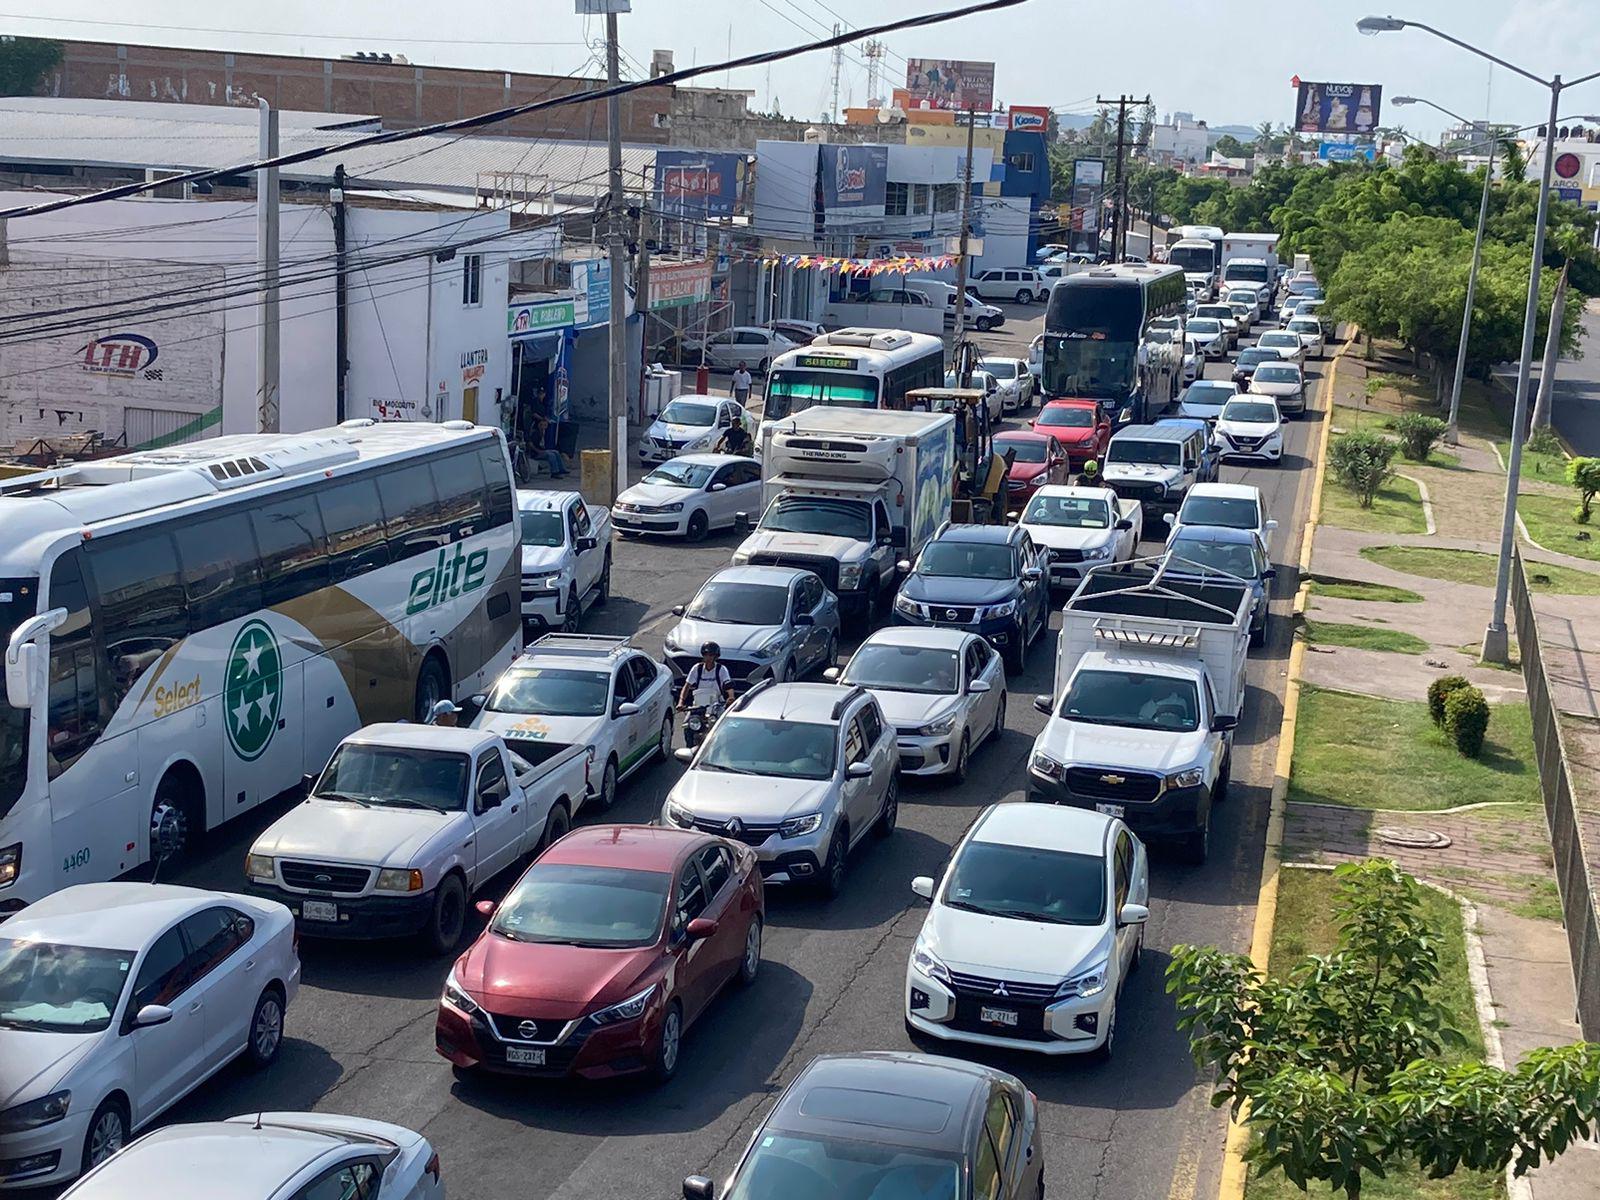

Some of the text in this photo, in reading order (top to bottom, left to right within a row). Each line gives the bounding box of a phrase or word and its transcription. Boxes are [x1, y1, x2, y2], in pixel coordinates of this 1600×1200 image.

[1326, 85, 1353, 94] NUEVOS
[1014, 114, 1042, 126] Kiosko
[84, 341, 142, 368] LTH
[460, 348, 488, 368] LLANTERA
[802, 450, 830, 458] THERMO
[406, 541, 489, 616] elite
[153, 673, 201, 718] Select
[504, 728, 549, 741] TAXI
[62, 846, 91, 873] 4460
